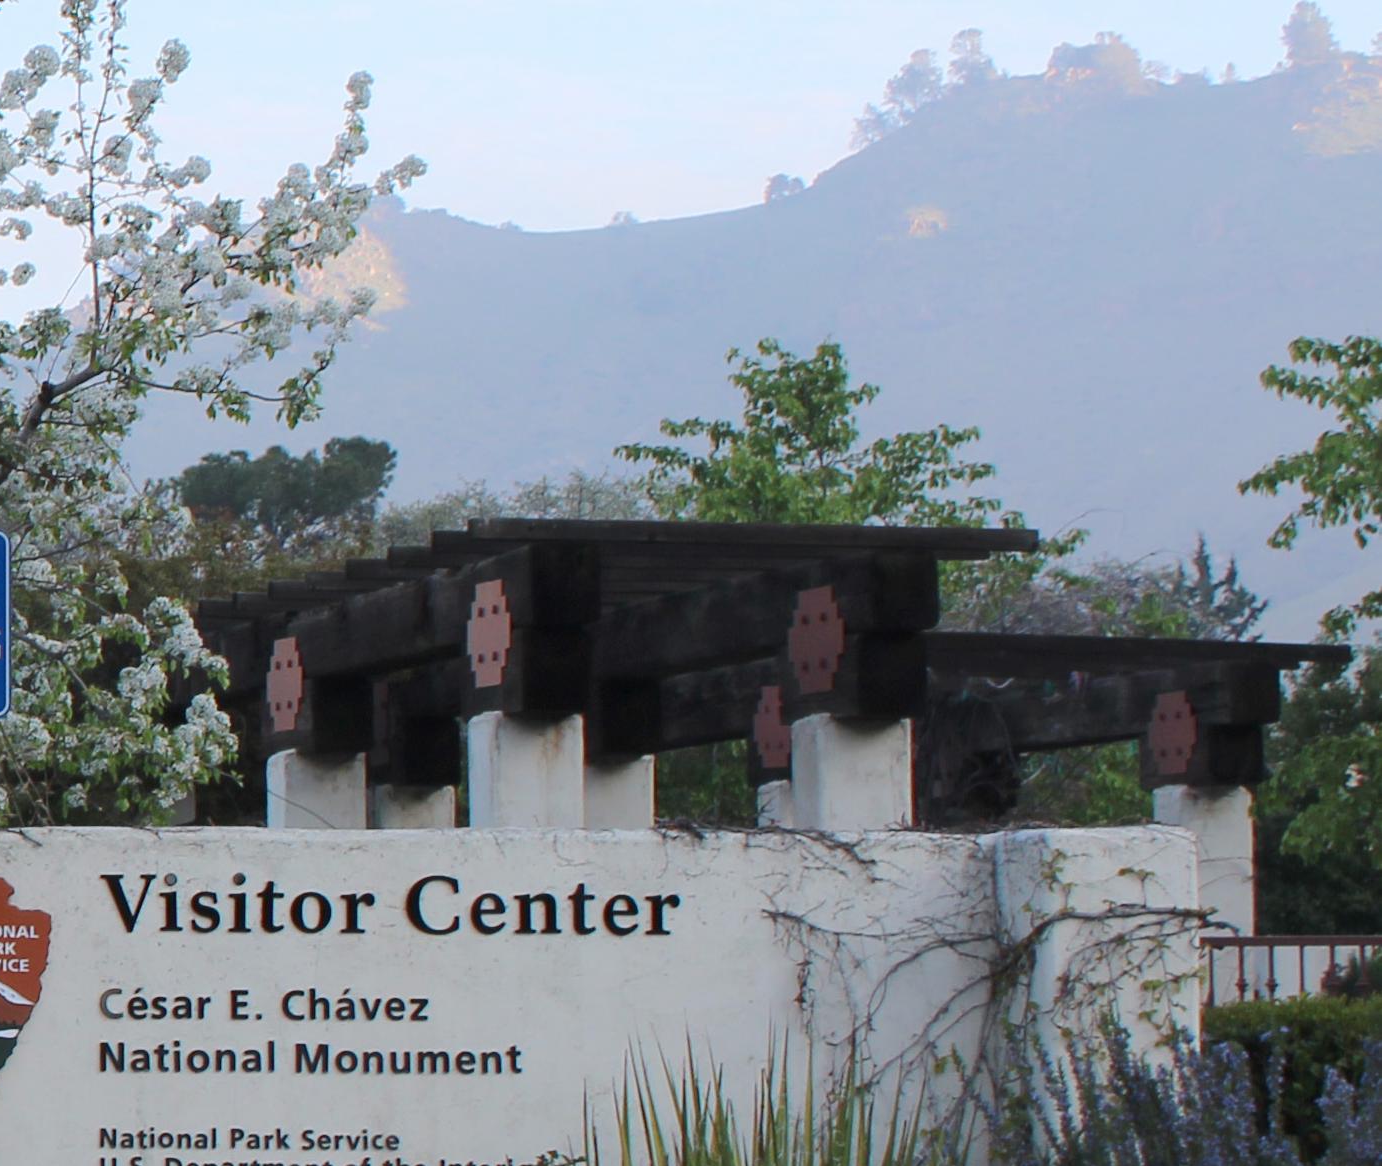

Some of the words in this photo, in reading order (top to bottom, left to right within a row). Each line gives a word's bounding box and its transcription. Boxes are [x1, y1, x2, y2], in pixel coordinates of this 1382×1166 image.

[100, 873, 375, 934] Visitor
[405, 875, 680, 936] Center
[99, 987, 211, 1020] César
[229, 989, 263, 1020] E.
[281, 988, 429, 1021] Chávez
[99, 1040, 275, 1073] National
[294, 1043, 522, 1074] Monument
[99, 1128, 217, 1149] National
[230, 1128, 289, 1150] Park
[301, 1129, 399, 1151] Service
